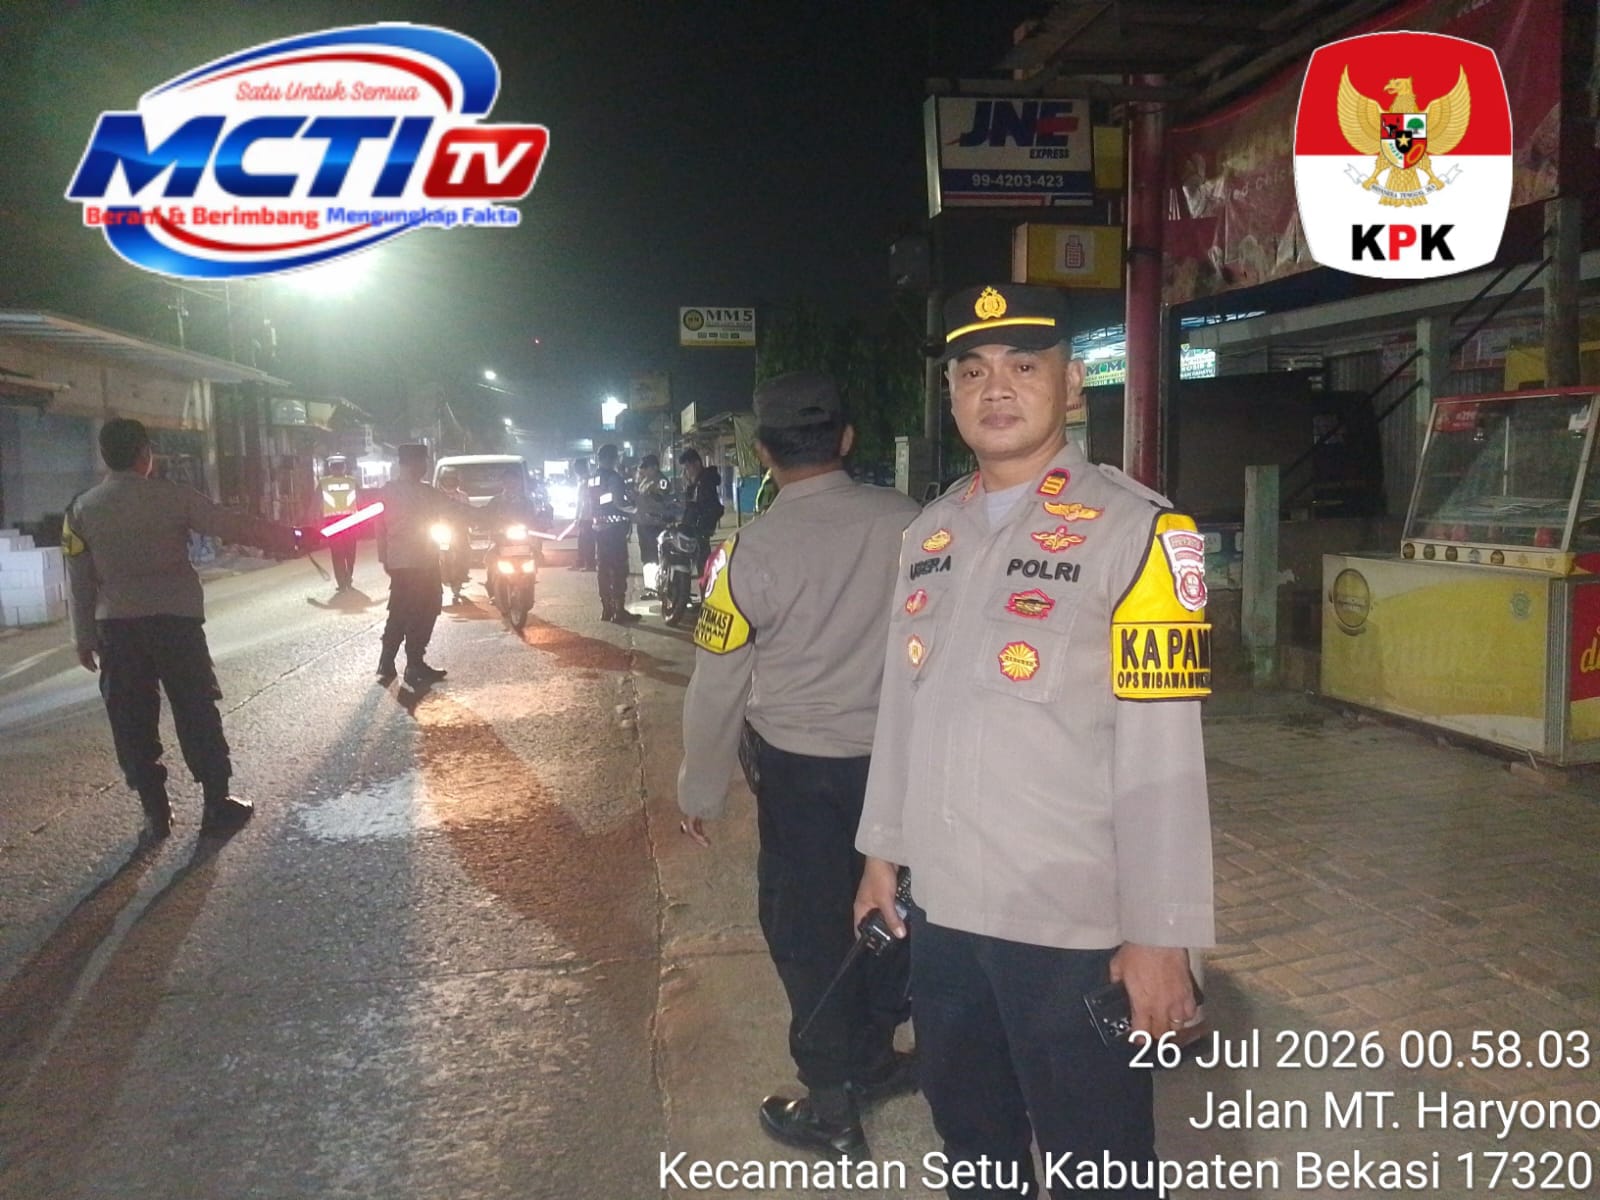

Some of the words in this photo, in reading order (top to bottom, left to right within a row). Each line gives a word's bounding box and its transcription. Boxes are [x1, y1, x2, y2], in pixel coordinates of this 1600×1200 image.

[958, 101, 1079, 147] JNE
[1029, 148, 1070, 159] EXPRESS
[971, 172, 1065, 188] 99-4203-423
[1006, 558, 1081, 583] POLRI
[1117, 671, 1139, 688] OPS
